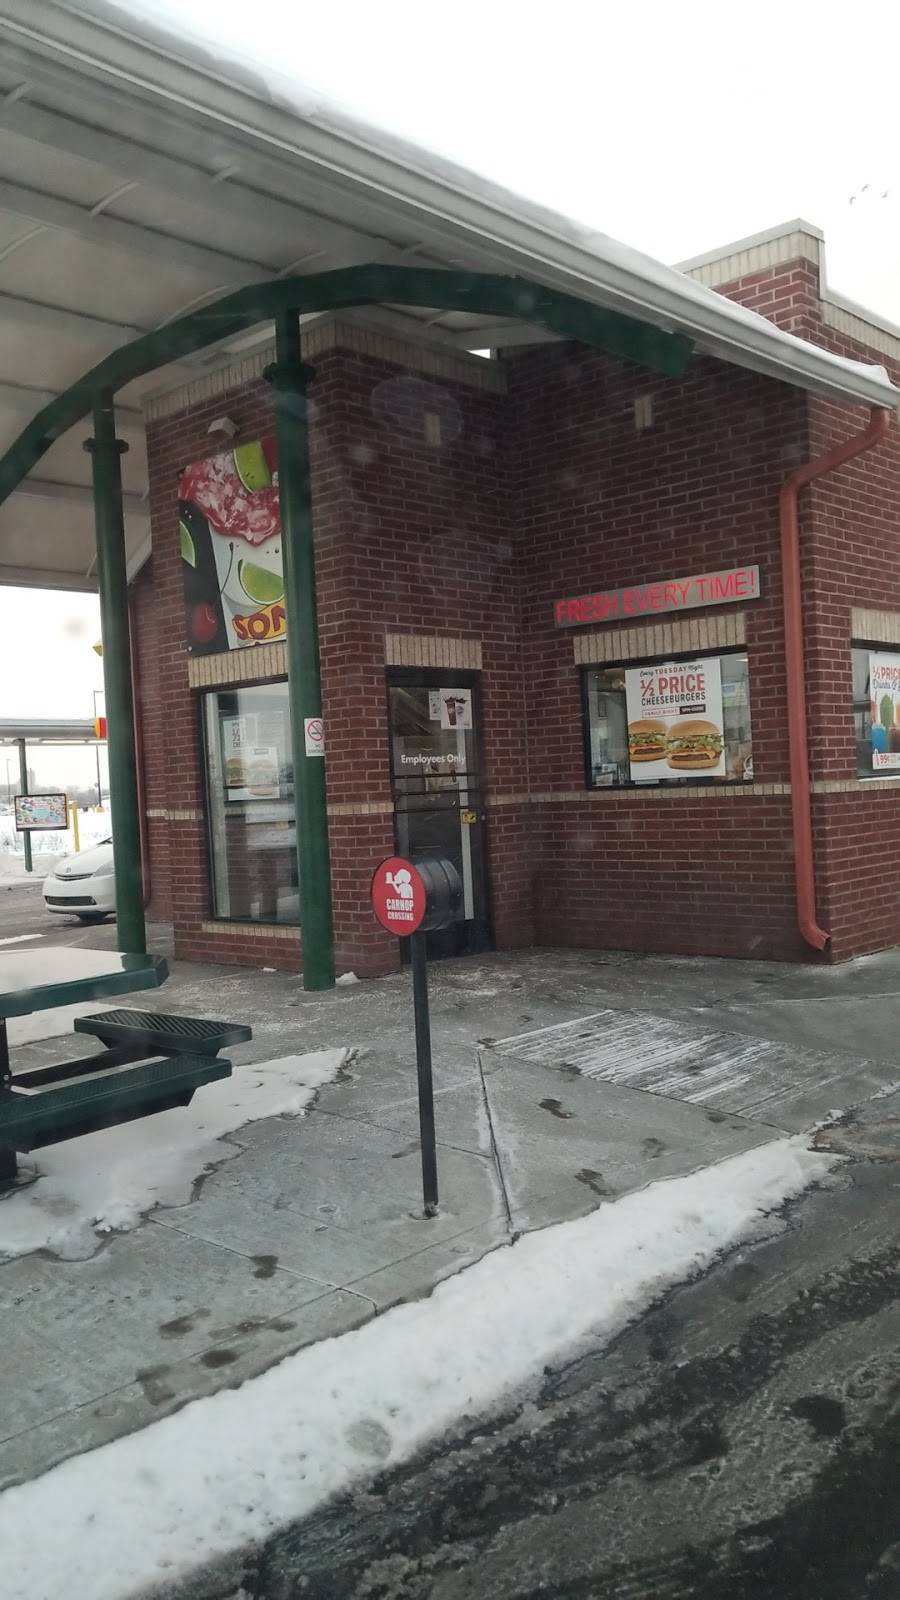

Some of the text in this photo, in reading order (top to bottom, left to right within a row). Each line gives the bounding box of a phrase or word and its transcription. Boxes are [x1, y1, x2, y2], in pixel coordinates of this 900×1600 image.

[556, 571, 755, 625] FRESH EVERY TIME!
[655, 666, 687, 675] TUESDAY
[658, 673, 705, 696] PRICE
[641, 692, 706, 706] CHEESEBURGERS
[401, 753, 466, 766] Employees Only
[386, 898, 414, 911] CARHOP
[387, 911, 414, 921] CROSSING
